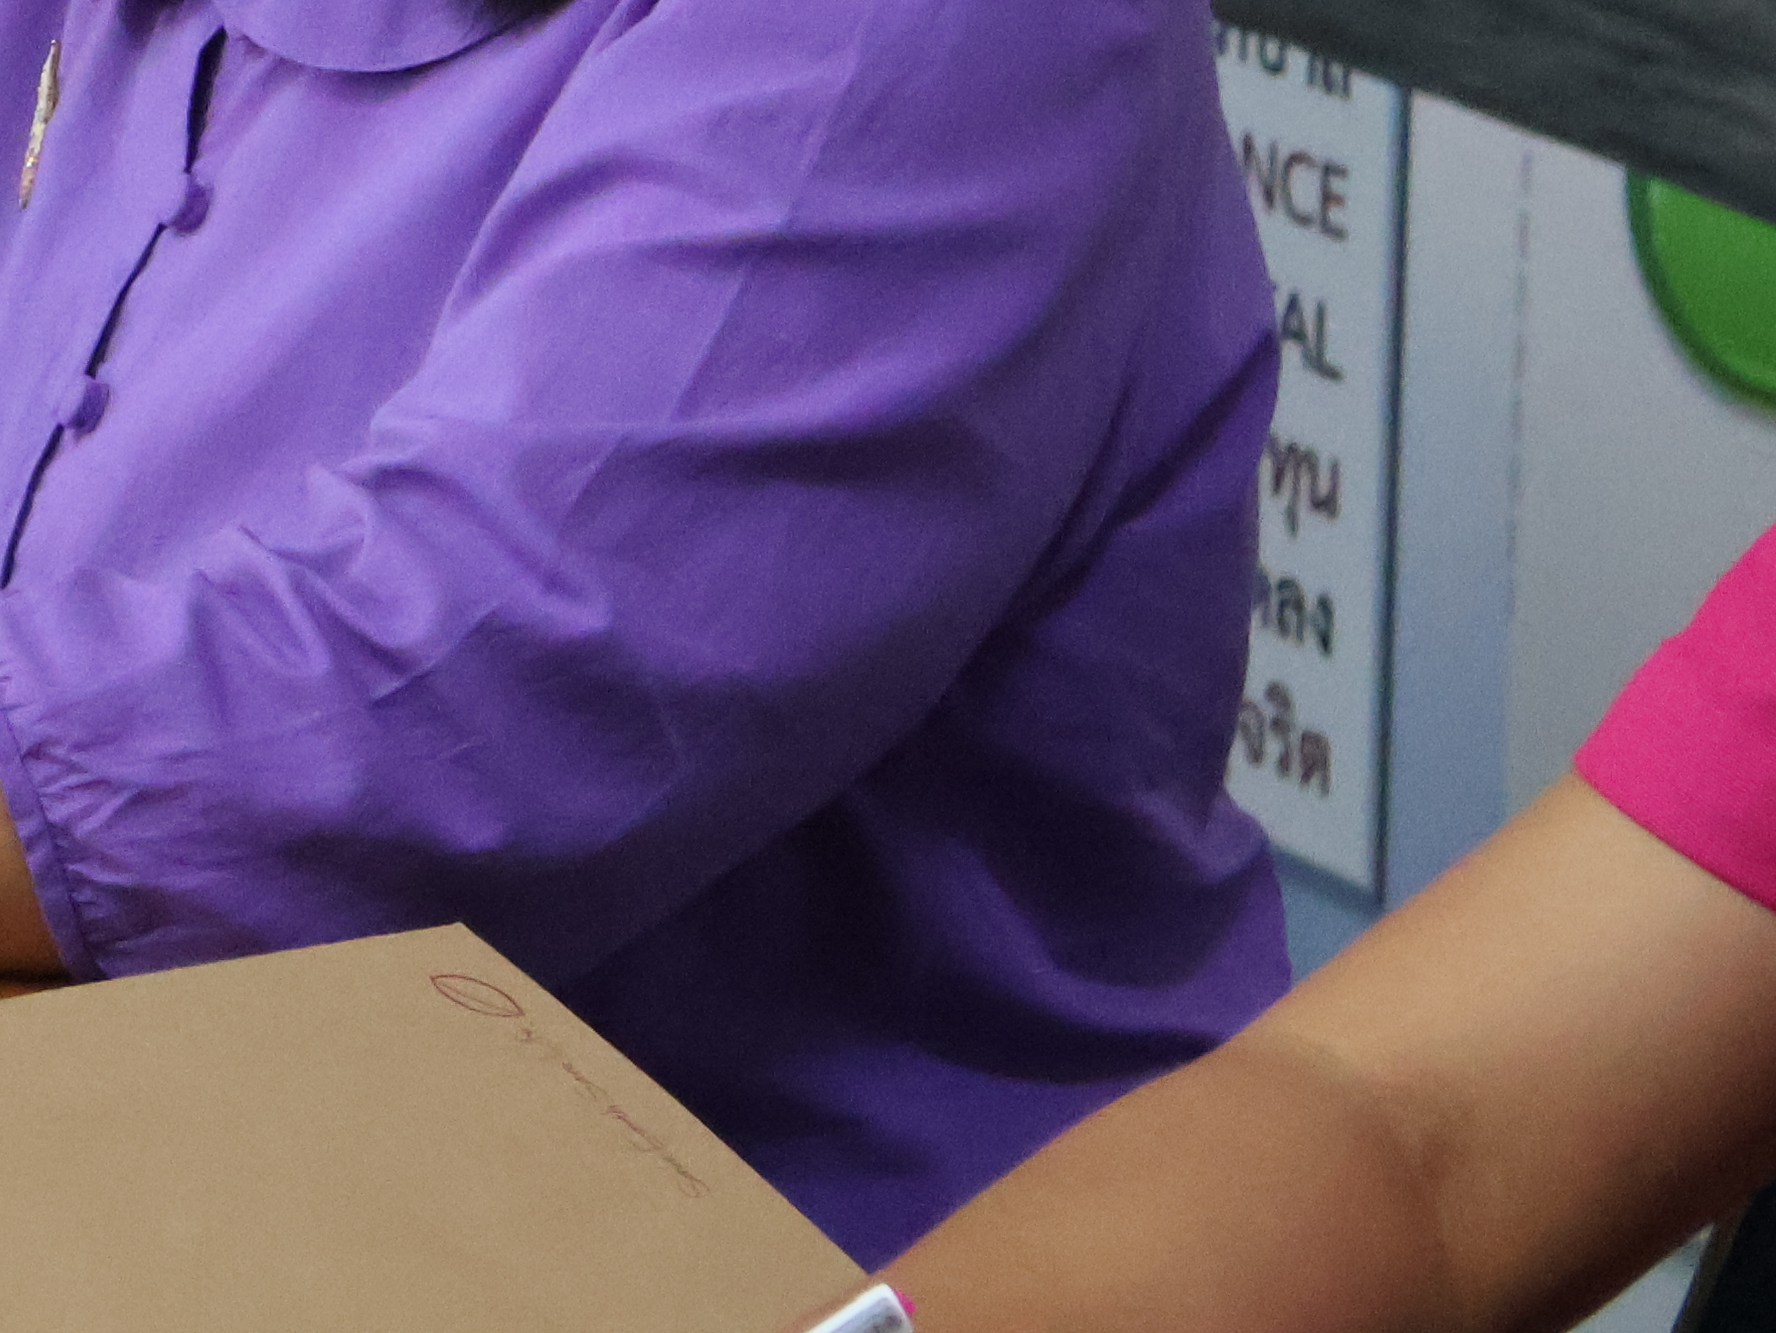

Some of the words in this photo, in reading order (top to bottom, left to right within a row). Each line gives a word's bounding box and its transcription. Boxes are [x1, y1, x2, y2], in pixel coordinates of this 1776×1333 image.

[1243, 131, 1350, 241] NCE
[1280, 291, 1345, 383] AL
[1264, 436, 1341, 535] ทุน
